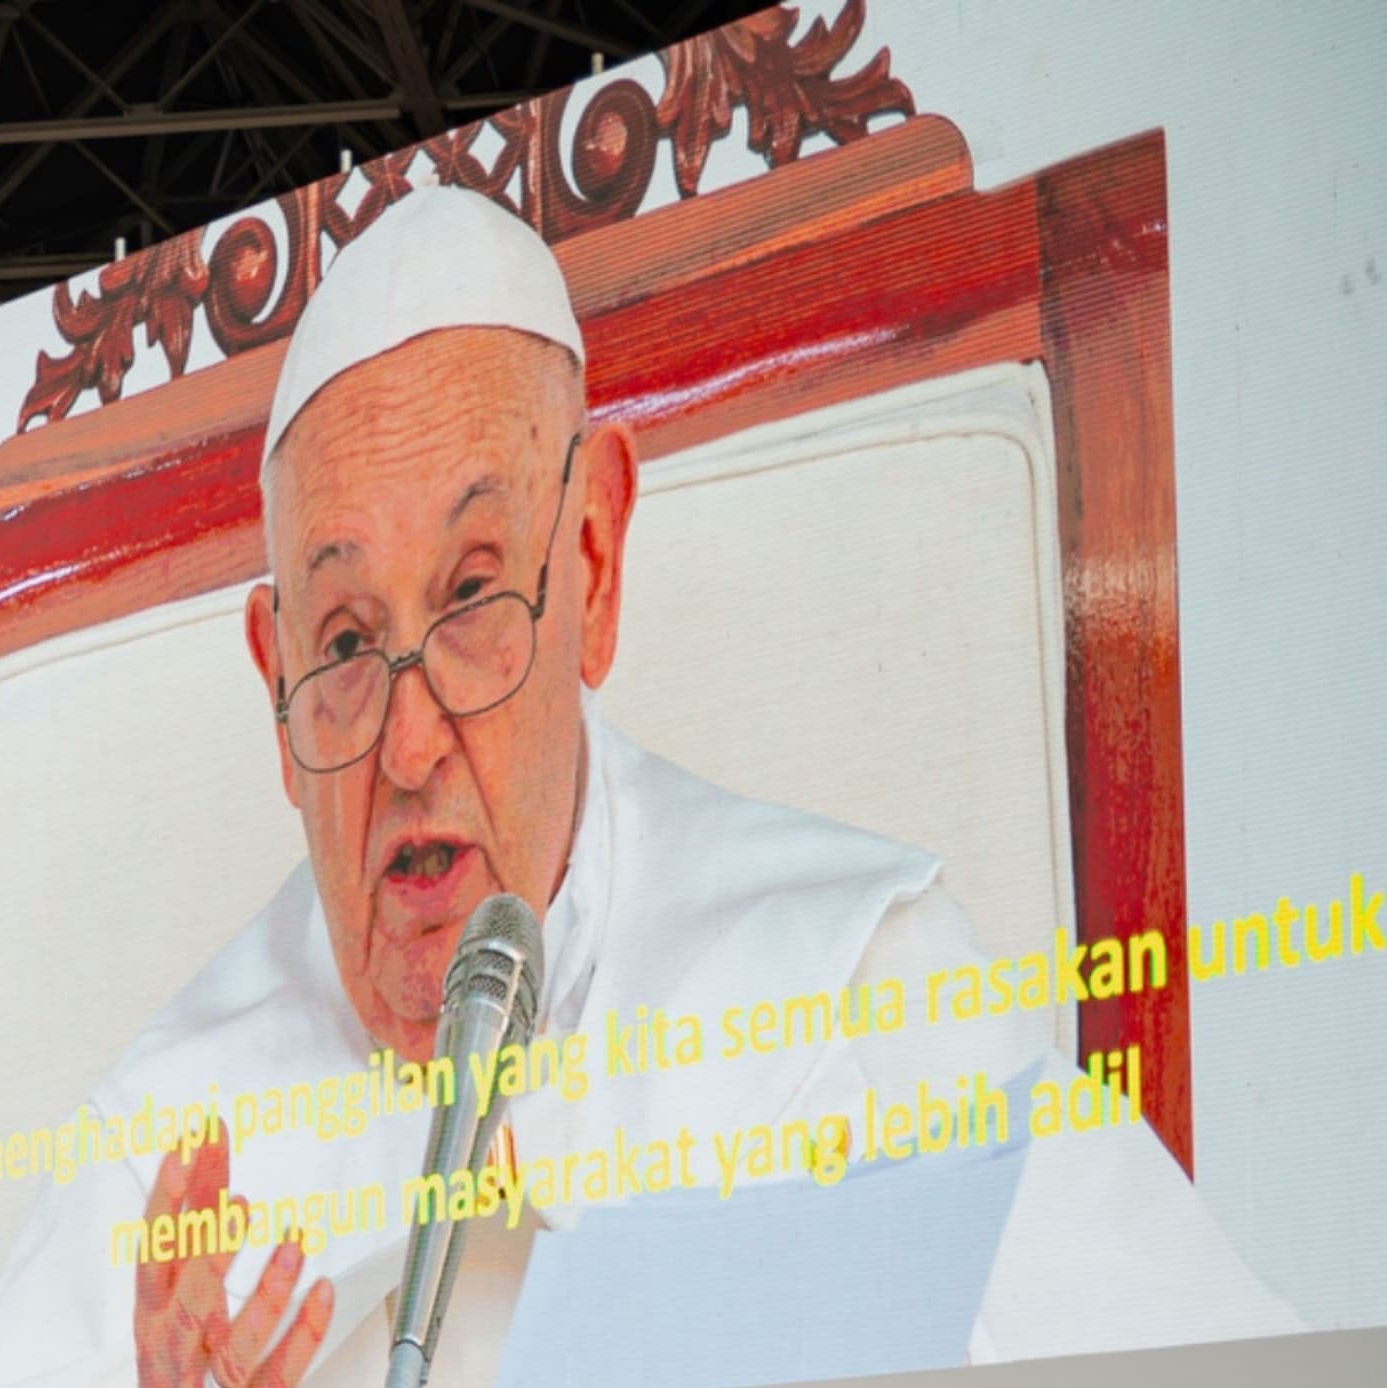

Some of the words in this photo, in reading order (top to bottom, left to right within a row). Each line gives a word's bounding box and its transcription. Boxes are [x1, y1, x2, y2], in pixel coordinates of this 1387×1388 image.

[234, 1048, 456, 1153] panggilan
[470, 1030, 590, 1119] yang
[606, 1004, 704, 1078] kita
[720, 975, 907, 1060] semua
[926, 925, 1169, 1026] rasakan
[1187, 871, 1387, 983] untuk
[110, 1184, 385, 1267] membangun
[402, 1125, 698, 1230] masyarakat
[713, 1115, 849, 1198] yang
[862, 1070, 1011, 1163] lebih
[1027, 1043, 1143, 1138] adil
